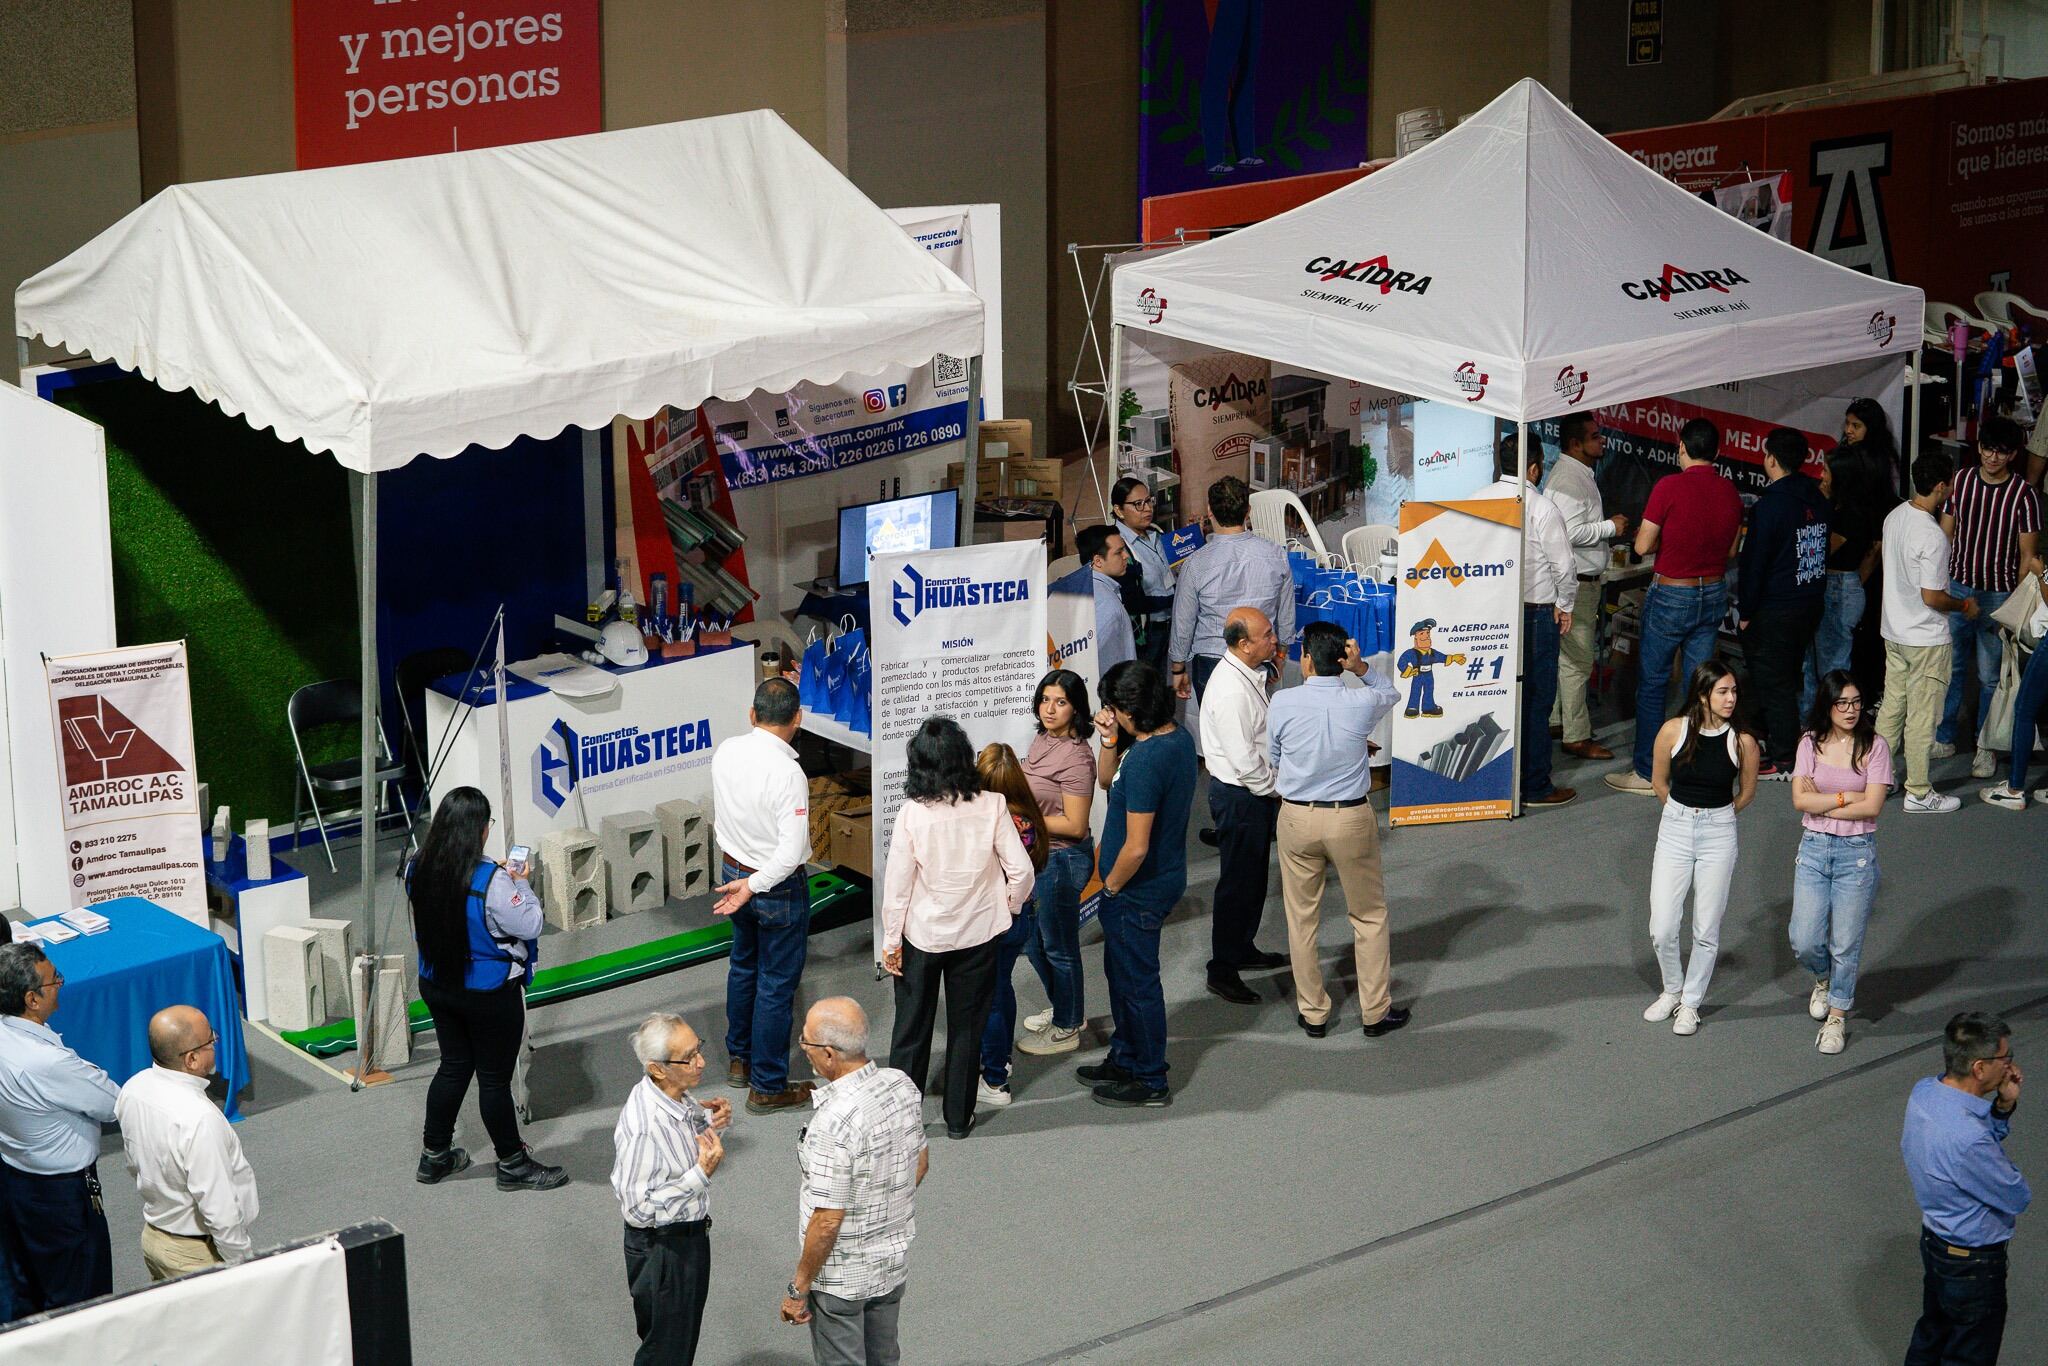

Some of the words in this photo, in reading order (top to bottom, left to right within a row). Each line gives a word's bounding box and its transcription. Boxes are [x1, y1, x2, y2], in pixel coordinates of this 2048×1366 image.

[339, 33, 369, 75] y
[381, 12, 563, 62] mejores
[345, 66, 560, 130] personas
[1956, 122, 2016, 148] Somos
[2019, 111, 2048, 138] má
[1957, 154, 1990, 181] que
[1951, 195, 1987, 213] cuando
[1988, 195, 2005, 208] nos
[1959, 214, 1973, 228] los
[1974, 212, 1998, 225] unos
[1999, 210, 2006, 220] a
[2007, 206, 2021, 219] los
[2021, 203, 2045, 217] otros
[913, 229, 958, 243] TRUCCIÓN
[934, 238, 963, 250] REGIÓN
[1304, 255, 1433, 296] CALIDRA
[1621, 266, 1751, 301] CALIDRA
[1300, 289, 1356, 307] SIEMPRE
[1351, 301, 1382, 313] AHÍ
[1673, 303, 1729, 320] SIEMPRE
[1729, 299, 1751, 312] AHÍ
[1193, 378, 1267, 408] CALIDRA
[668, 409, 696, 435] Ternium
[813, 409, 856, 425] @acerotam
[1635, 406, 1690, 435] FÓRM
[757, 420, 905, 461] www.acerotam.com.mx
[773, 428, 798, 440] GERDAU
[772, 462, 795, 478] 454
[838, 449, 863, 465] 226
[865, 439, 896, 458] 0226
[904, 431, 928, 449] 226
[930, 423, 961, 442] 0890
[1216, 437, 1252, 455] CALIDR
[1418, 451, 1457, 467] CALIDRA
[925, 576, 971, 588] Concretos
[925, 579, 1029, 609] HUASTECA
[1448, 632, 1510, 643] CONSTRUCCIÓN
[1451, 623, 1488, 633] ACERO
[1489, 623, 1510, 631] PARA
[942, 636, 974, 650] MISIÓN
[1047, 636, 1088, 667] rotam
[1470, 644, 1498, 652] SOMOS
[61, 666, 97, 676] ASOCIACIÓN
[97, 663, 128, 672] MEXICANA
[137, 656, 173, 667] DIRECTORES
[881, 660, 909, 672] Fabricar
[922, 659, 928, 668] y
[941, 654, 990, 666] comercializar
[1003, 648, 1035, 659] concreto
[51, 674, 96, 684] RESPONSABLES
[127, 662, 185, 676] CORRESPONSABLES,
[74, 678, 112, 688] DELEGACIÓN
[113, 674, 149, 684] TAMAULIPAS,
[881, 670, 927, 684] premezclado
[932, 671, 937, 679] y
[942, 666, 979, 677] productos
[984, 660, 1035, 673] prefabricados
[881, 682, 924, 696] cumpliendo
[941, 679, 953, 687] los
[954, 677, 971, 687] más
[972, 676, 992, 685] altos
[993, 672, 1035, 683] estándares
[1477, 689, 1508, 697] REGIÓN
[881, 697, 891, 707] de
[893, 694, 920, 705] calidad
[935, 690, 962, 701] precios
[965, 685, 1013, 698] competitivos
[1025, 683, 1035, 691] fin
[881, 709, 891, 718] de
[895, 705, 917, 716] lograr
[921, 704, 929, 712] la
[934, 699, 978, 711] satisfacción
[983, 700, 988, 708] y
[993, 695, 1035, 707] preferencia
[881, 720, 891, 729] de
[893, 717, 925, 728] nuestros
[973, 708, 1008, 719] cualquier
[581, 725, 639, 748] Concretos
[881, 731, 905, 741] donde
[905, 730, 919, 739] ope
[581, 718, 713, 779] HUASTECA
[582, 780, 615, 795] Empresa
[615, 769, 653, 787] Certificada
[653, 768, 663, 778] en
[663, 764, 676, 777] ISO
[677, 756, 713, 772] 9001:2015
[883, 770, 909, 780] Contrib
[69, 778, 144, 801] AMDROC
[149, 773, 183, 789] A.C.
[883, 782, 905, 791] media
[69, 788, 184, 814] TAMAULIPAS
[883, 804, 902, 814] calid
[883, 817, 895, 825] me
[84, 839, 99, 849] 833
[100, 837, 115, 846] 210
[117, 833, 137, 843] 2275
[883, 829, 892, 837] qu
[86, 852, 117, 864] Amdroc
[118, 845, 167, 858] Tamaulipas
[88, 861, 199, 881] www.amdroctamaulipas.com
[86, 885, 128, 897] Prolongación
[129, 882, 148, 890] Agua
[149, 879, 168, 887] Dulce
[89, 894, 107, 904] Local
[138, 888, 151, 896] Col.
[153, 885, 184, 893] Petrolera
[147, 892, 161, 901] C.P.
[161, 890, 182, 899] 89110
